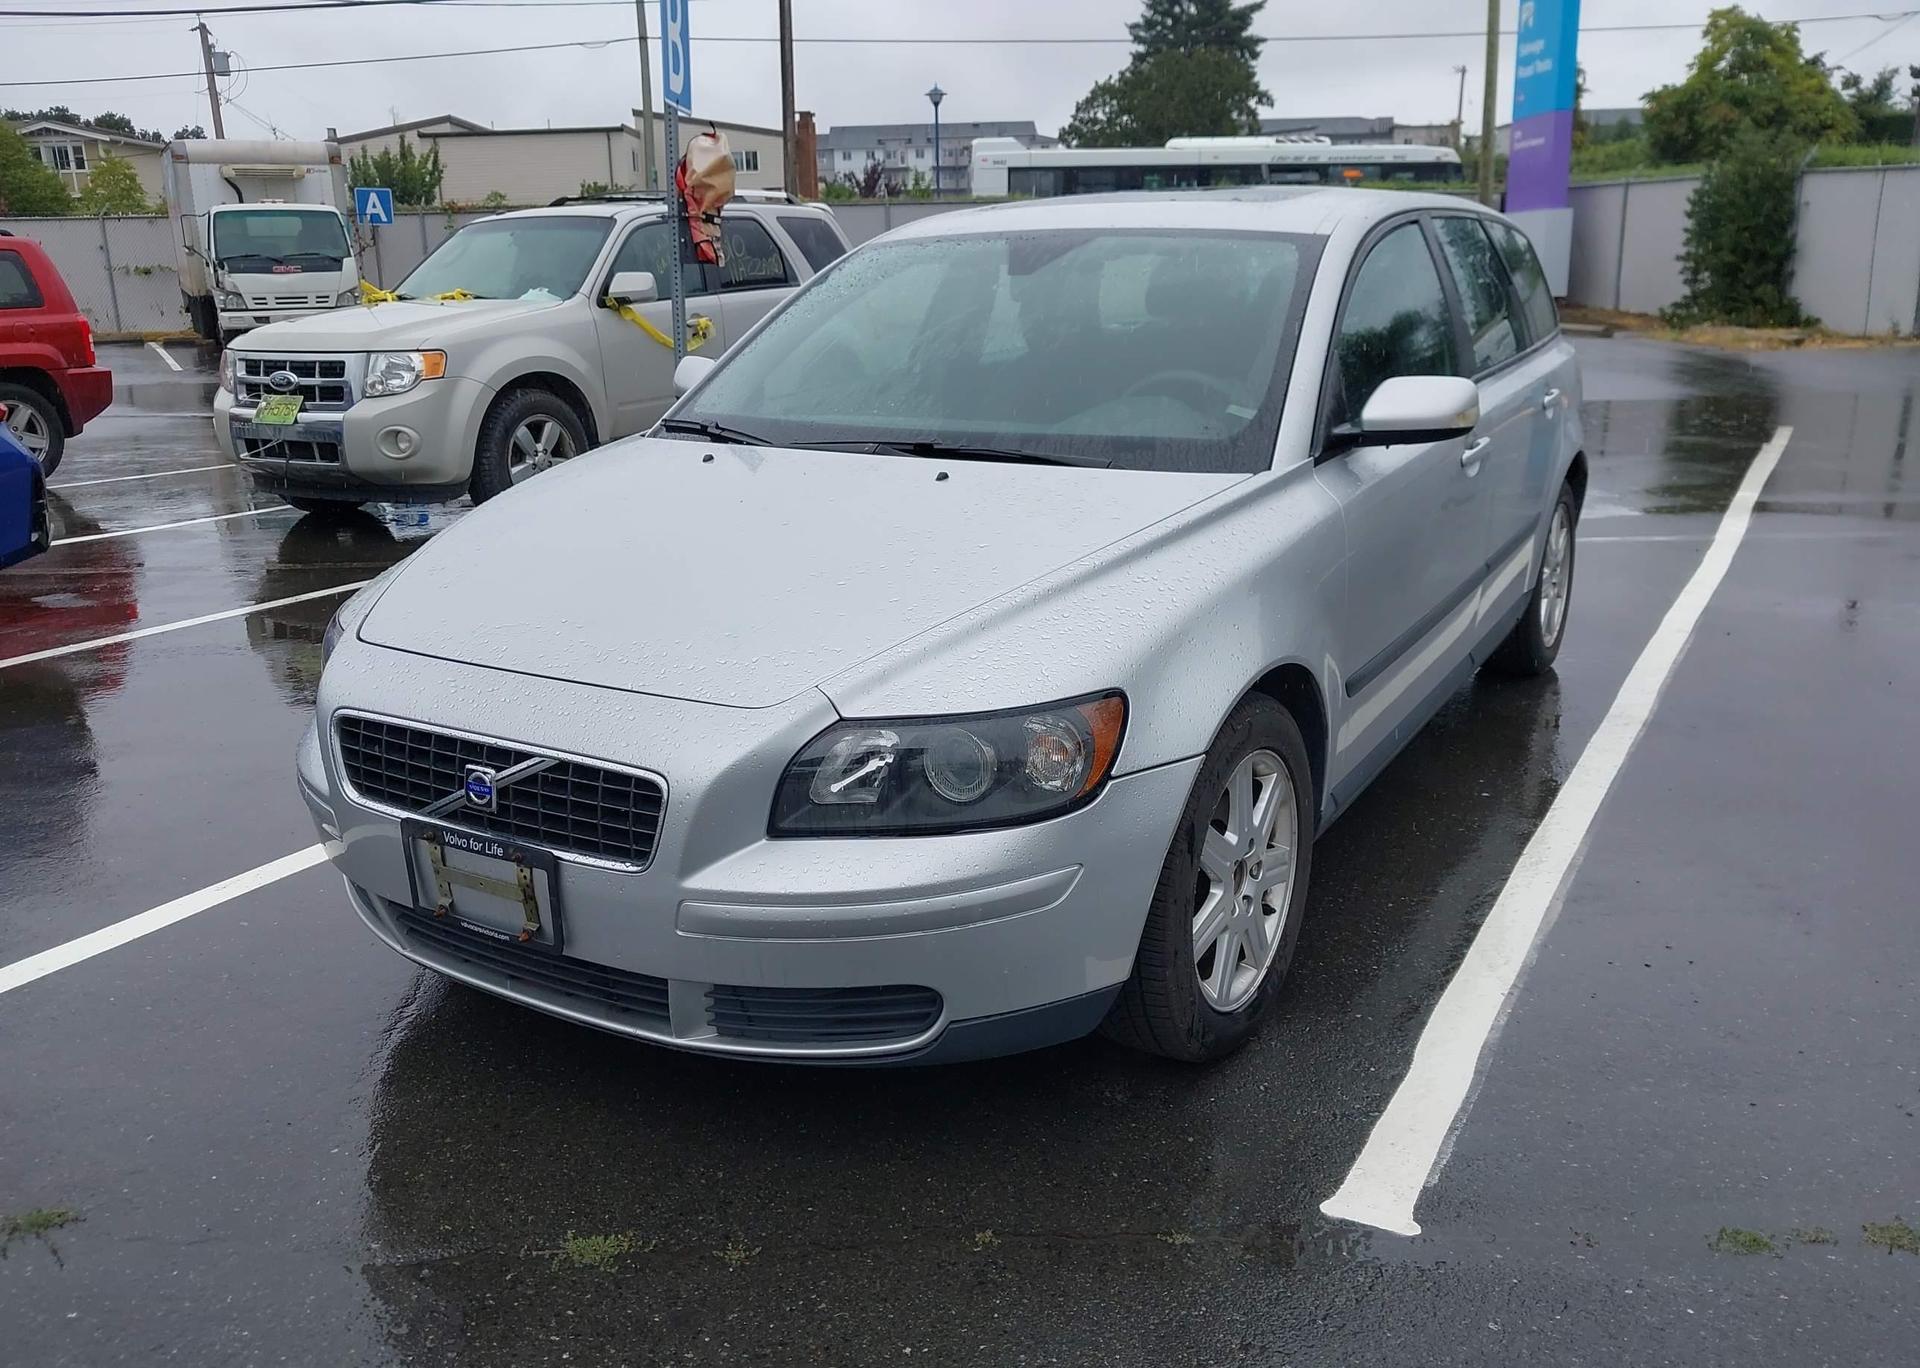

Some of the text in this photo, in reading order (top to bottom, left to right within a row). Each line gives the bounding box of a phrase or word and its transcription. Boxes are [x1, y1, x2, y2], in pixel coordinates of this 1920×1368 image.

[667, 0, 684, 95] B
[365, 191, 388, 222] A
[272, 264, 303, 273] GMC
[469, 783, 491, 793] VOLVO
[443, 831, 504, 857] Volvo for Life
